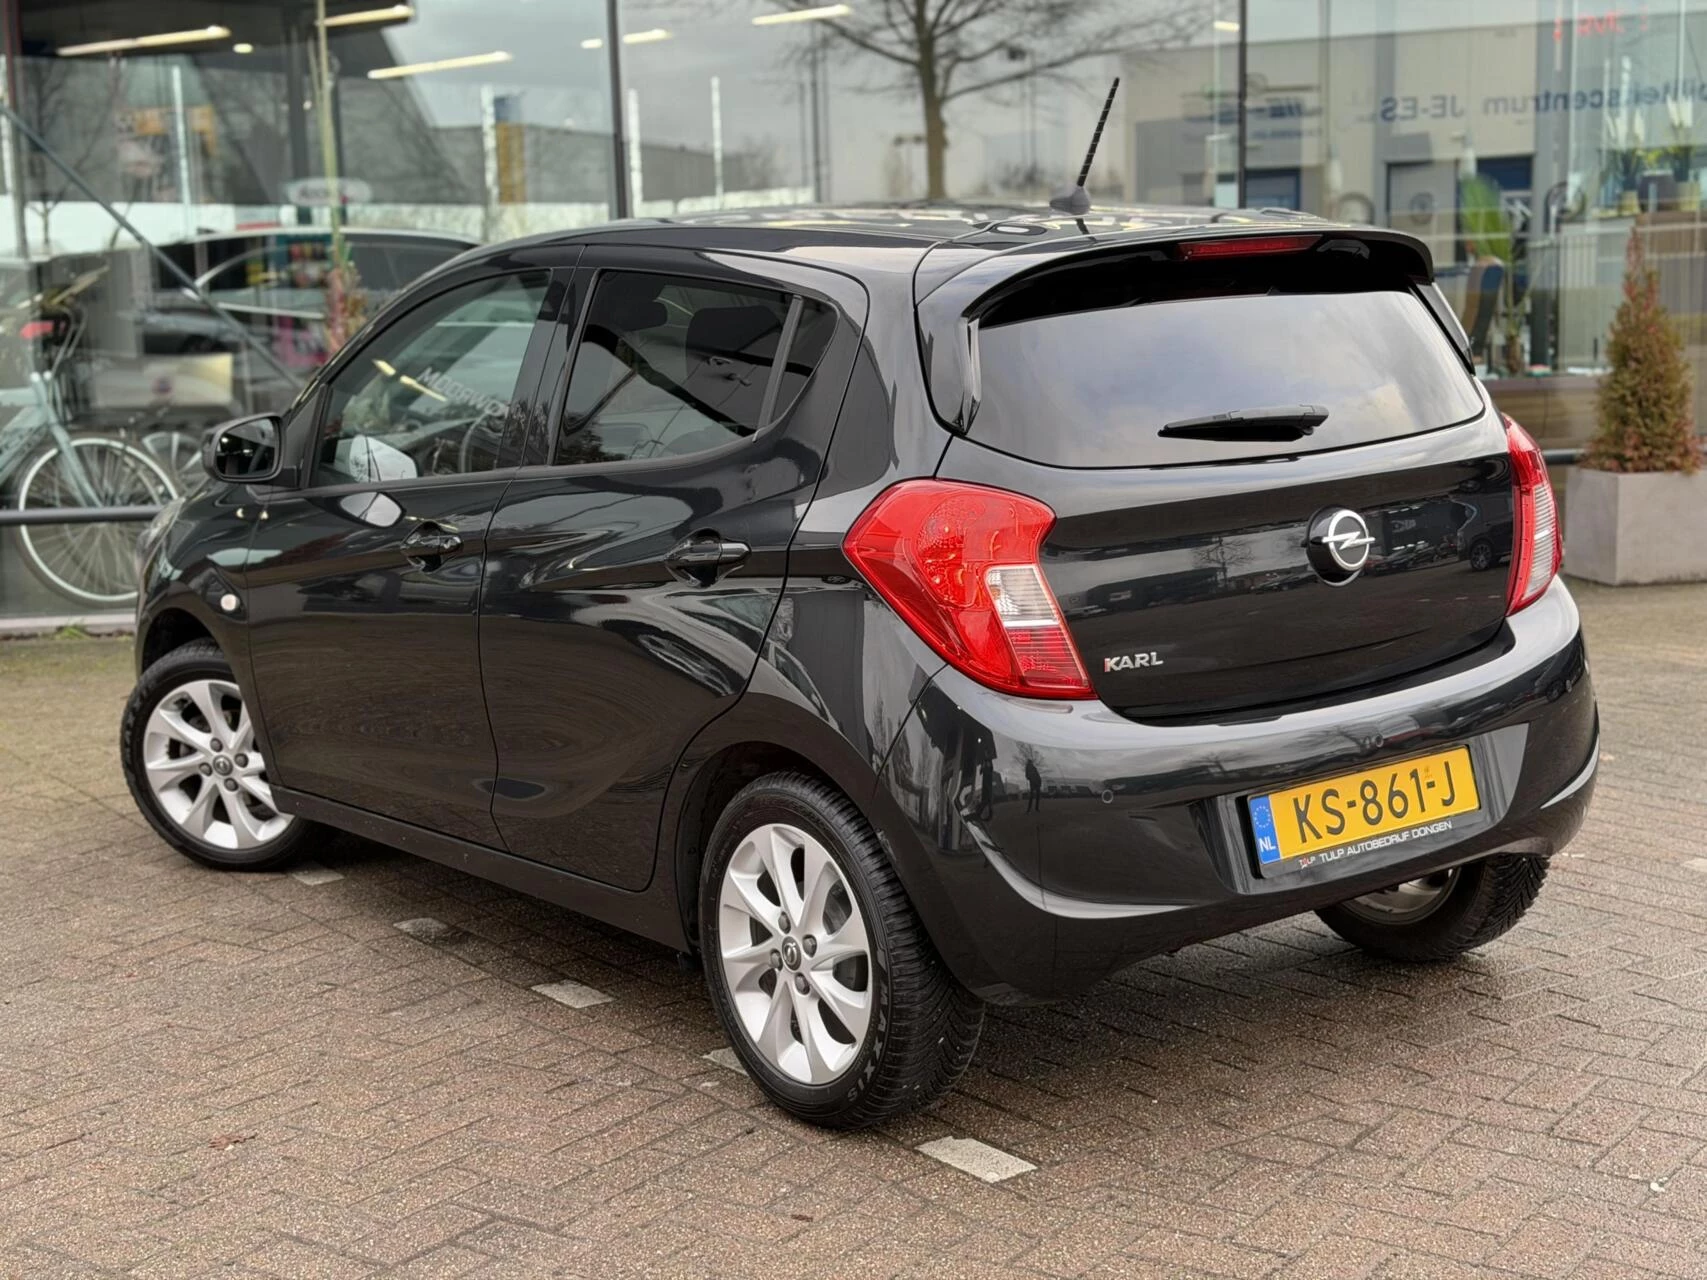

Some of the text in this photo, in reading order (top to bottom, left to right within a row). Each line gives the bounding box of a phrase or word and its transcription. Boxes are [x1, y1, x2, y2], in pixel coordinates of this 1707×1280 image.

[1104, 652, 1164, 673] KARL
[1292, 760, 1456, 844] KS-861-J
[1258, 836, 1277, 853] NL
[1319, 820, 1453, 864] TULP AUTOBEDRIJF DONGEN
